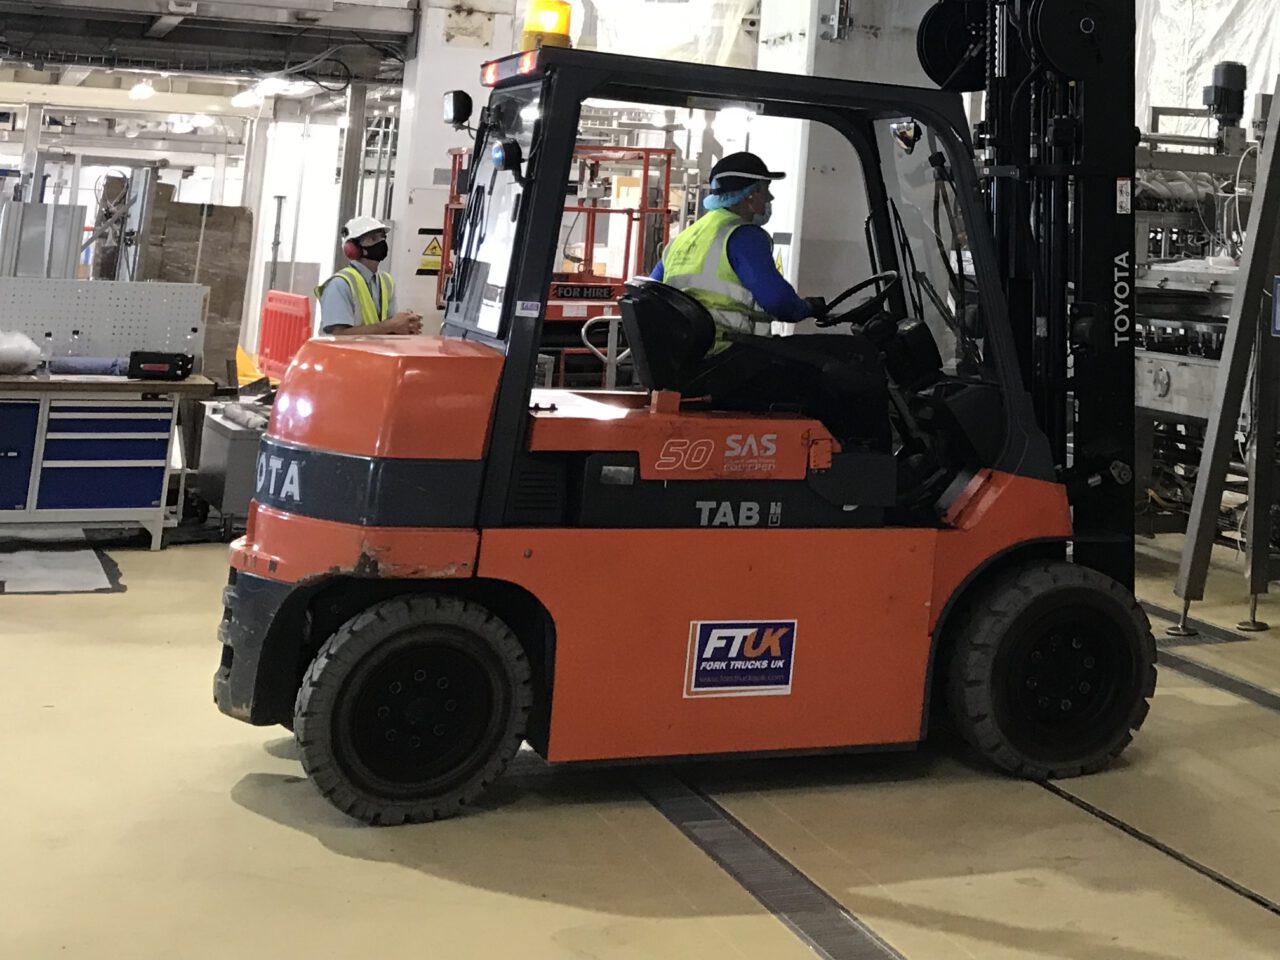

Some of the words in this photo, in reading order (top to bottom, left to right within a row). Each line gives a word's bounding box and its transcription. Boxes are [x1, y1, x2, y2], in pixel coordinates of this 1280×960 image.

[558, 287, 580, 297] FOR
[583, 287, 610, 298] HIRE
[1114, 251, 1130, 347] TOYOTA
[655, 440, 714, 470] 50
[725, 434, 777, 457] SAS
[696, 501, 760, 526] TAB
[703, 628, 790, 658] FTUK
[700, 661, 727, 670] FORK
[730, 660, 768, 670] TRUCKS
[771, 660, 785, 669] UK
